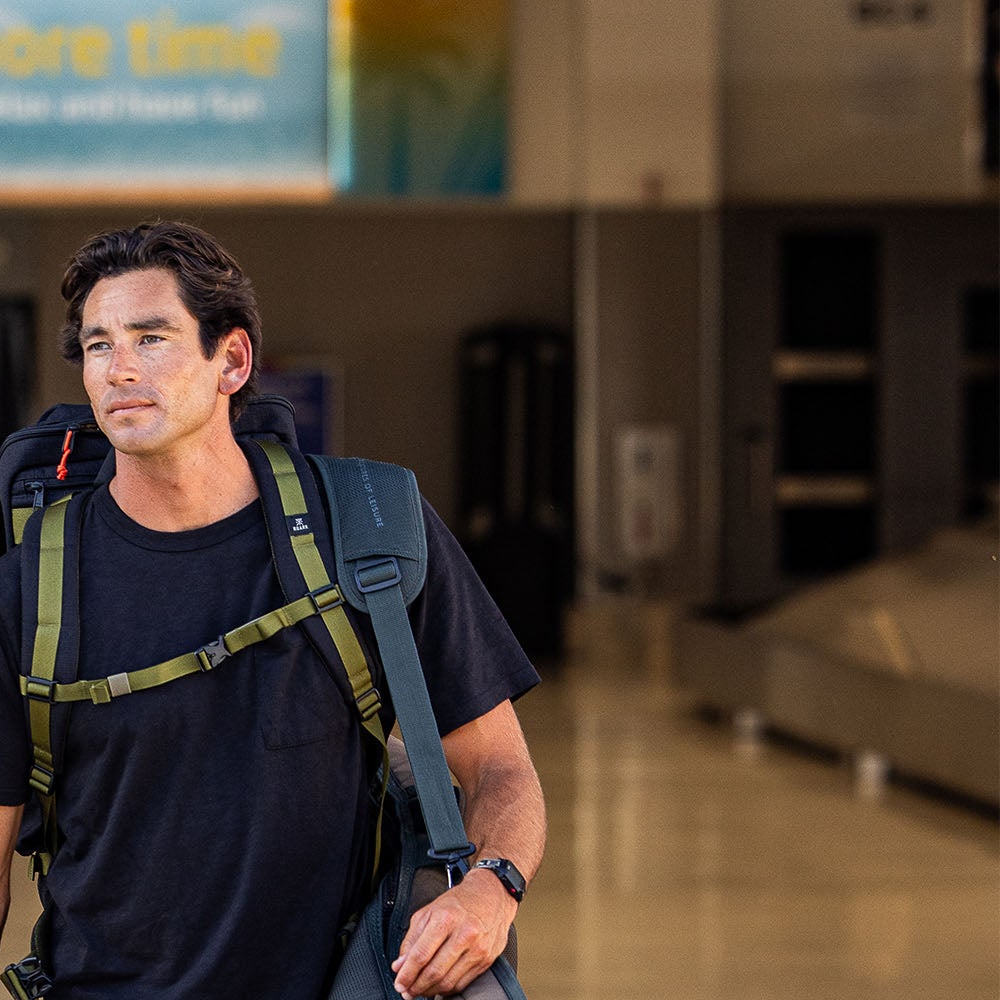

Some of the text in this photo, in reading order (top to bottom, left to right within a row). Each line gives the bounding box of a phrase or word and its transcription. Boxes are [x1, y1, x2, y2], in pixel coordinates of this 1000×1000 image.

[126, 8, 282, 77] time
[364, 483, 384, 528] OF LEISURE
